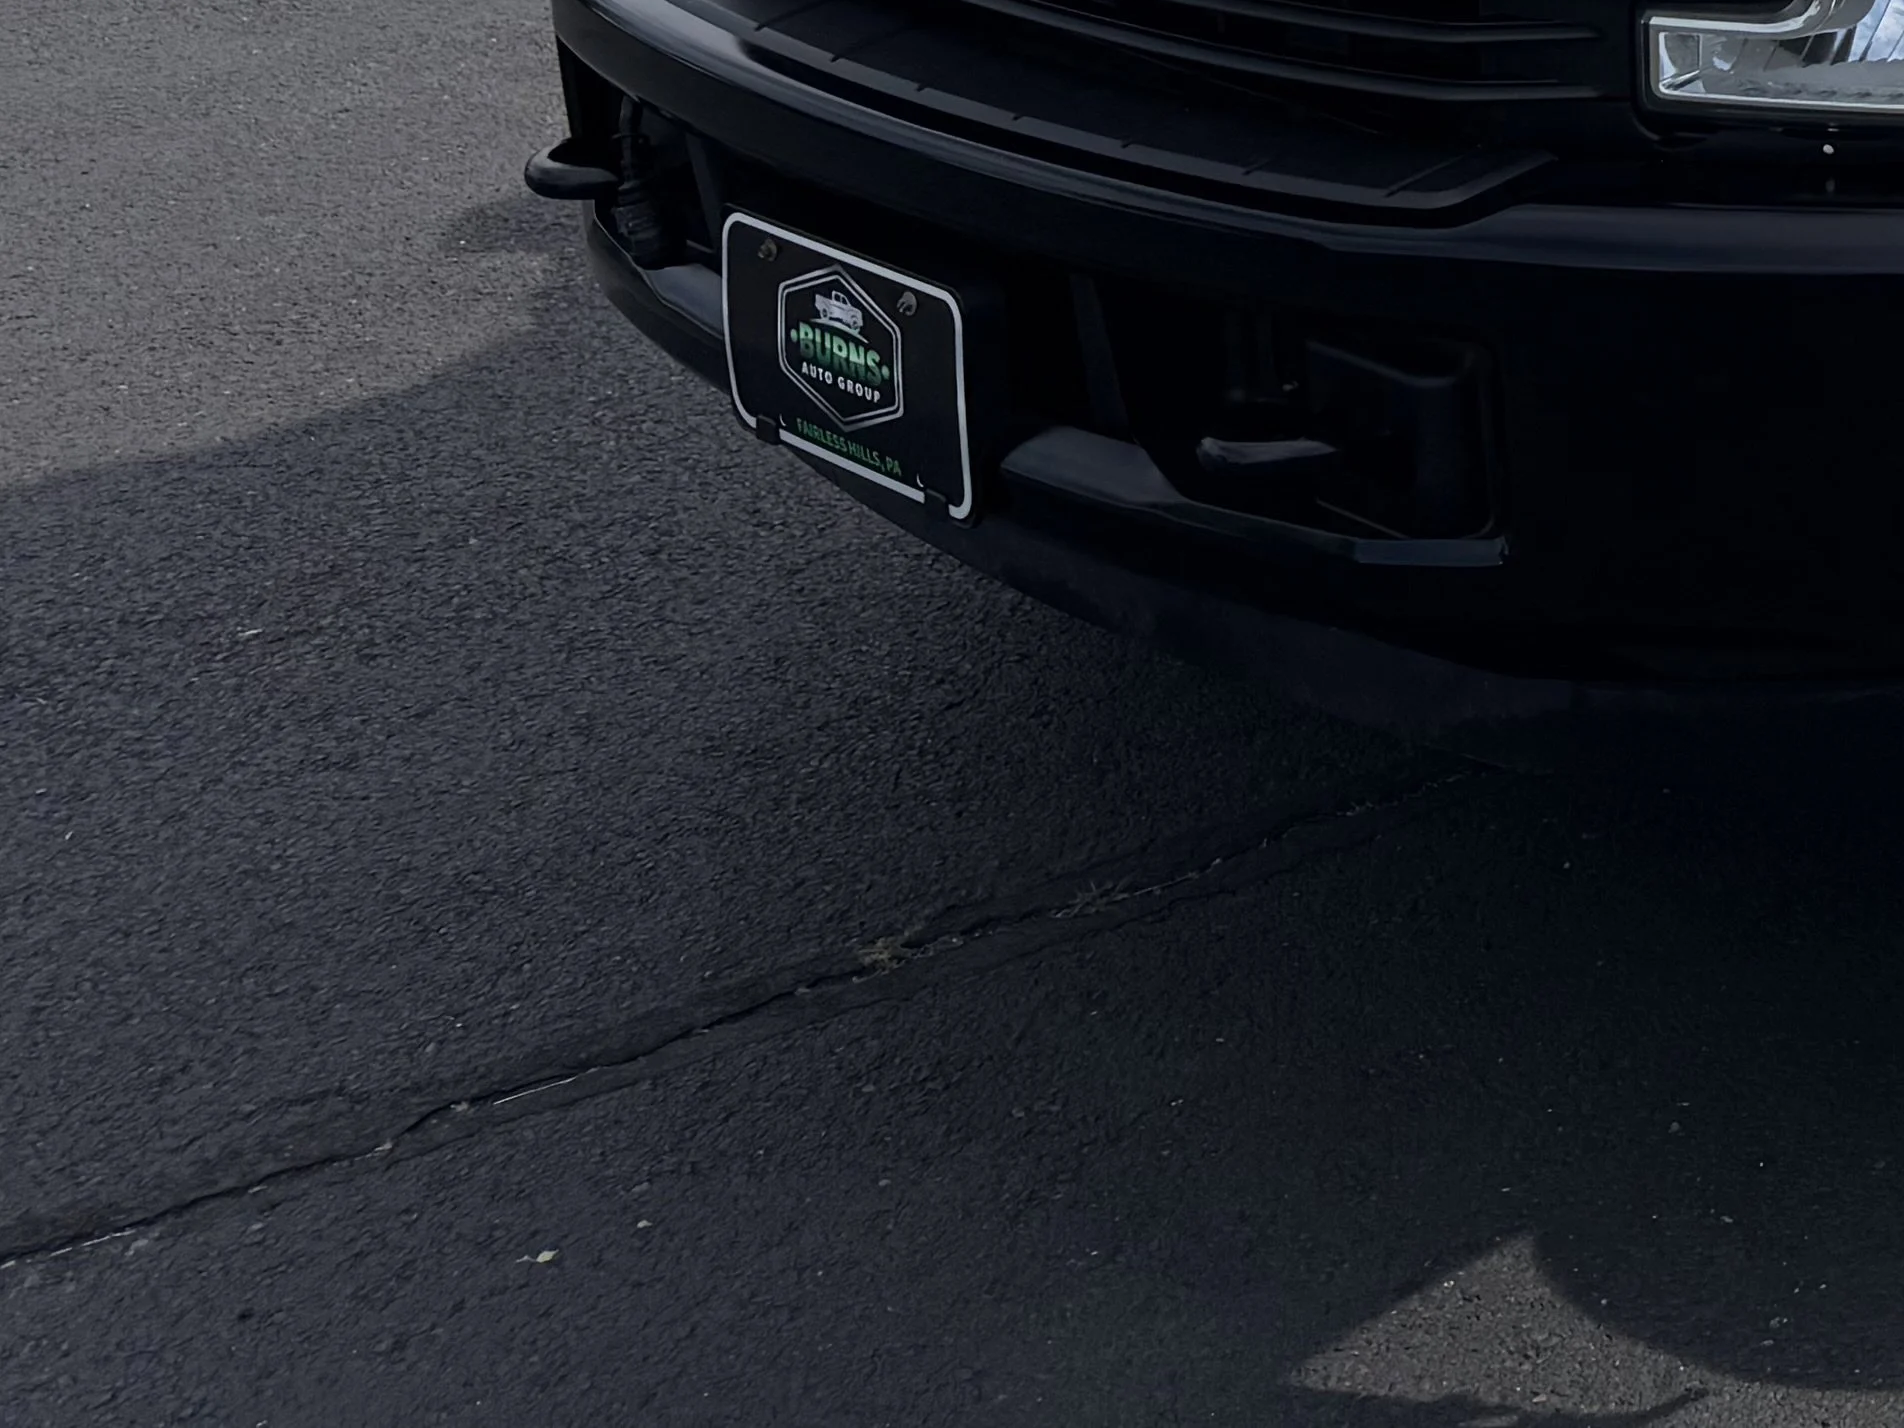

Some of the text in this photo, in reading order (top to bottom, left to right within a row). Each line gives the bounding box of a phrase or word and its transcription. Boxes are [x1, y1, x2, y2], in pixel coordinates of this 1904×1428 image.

[799, 321, 882, 386] BURNS
[801, 361, 881, 404] AUTO GROUP
[796, 417, 846, 454] FAIRLESS
[885, 455, 902, 476] PA
